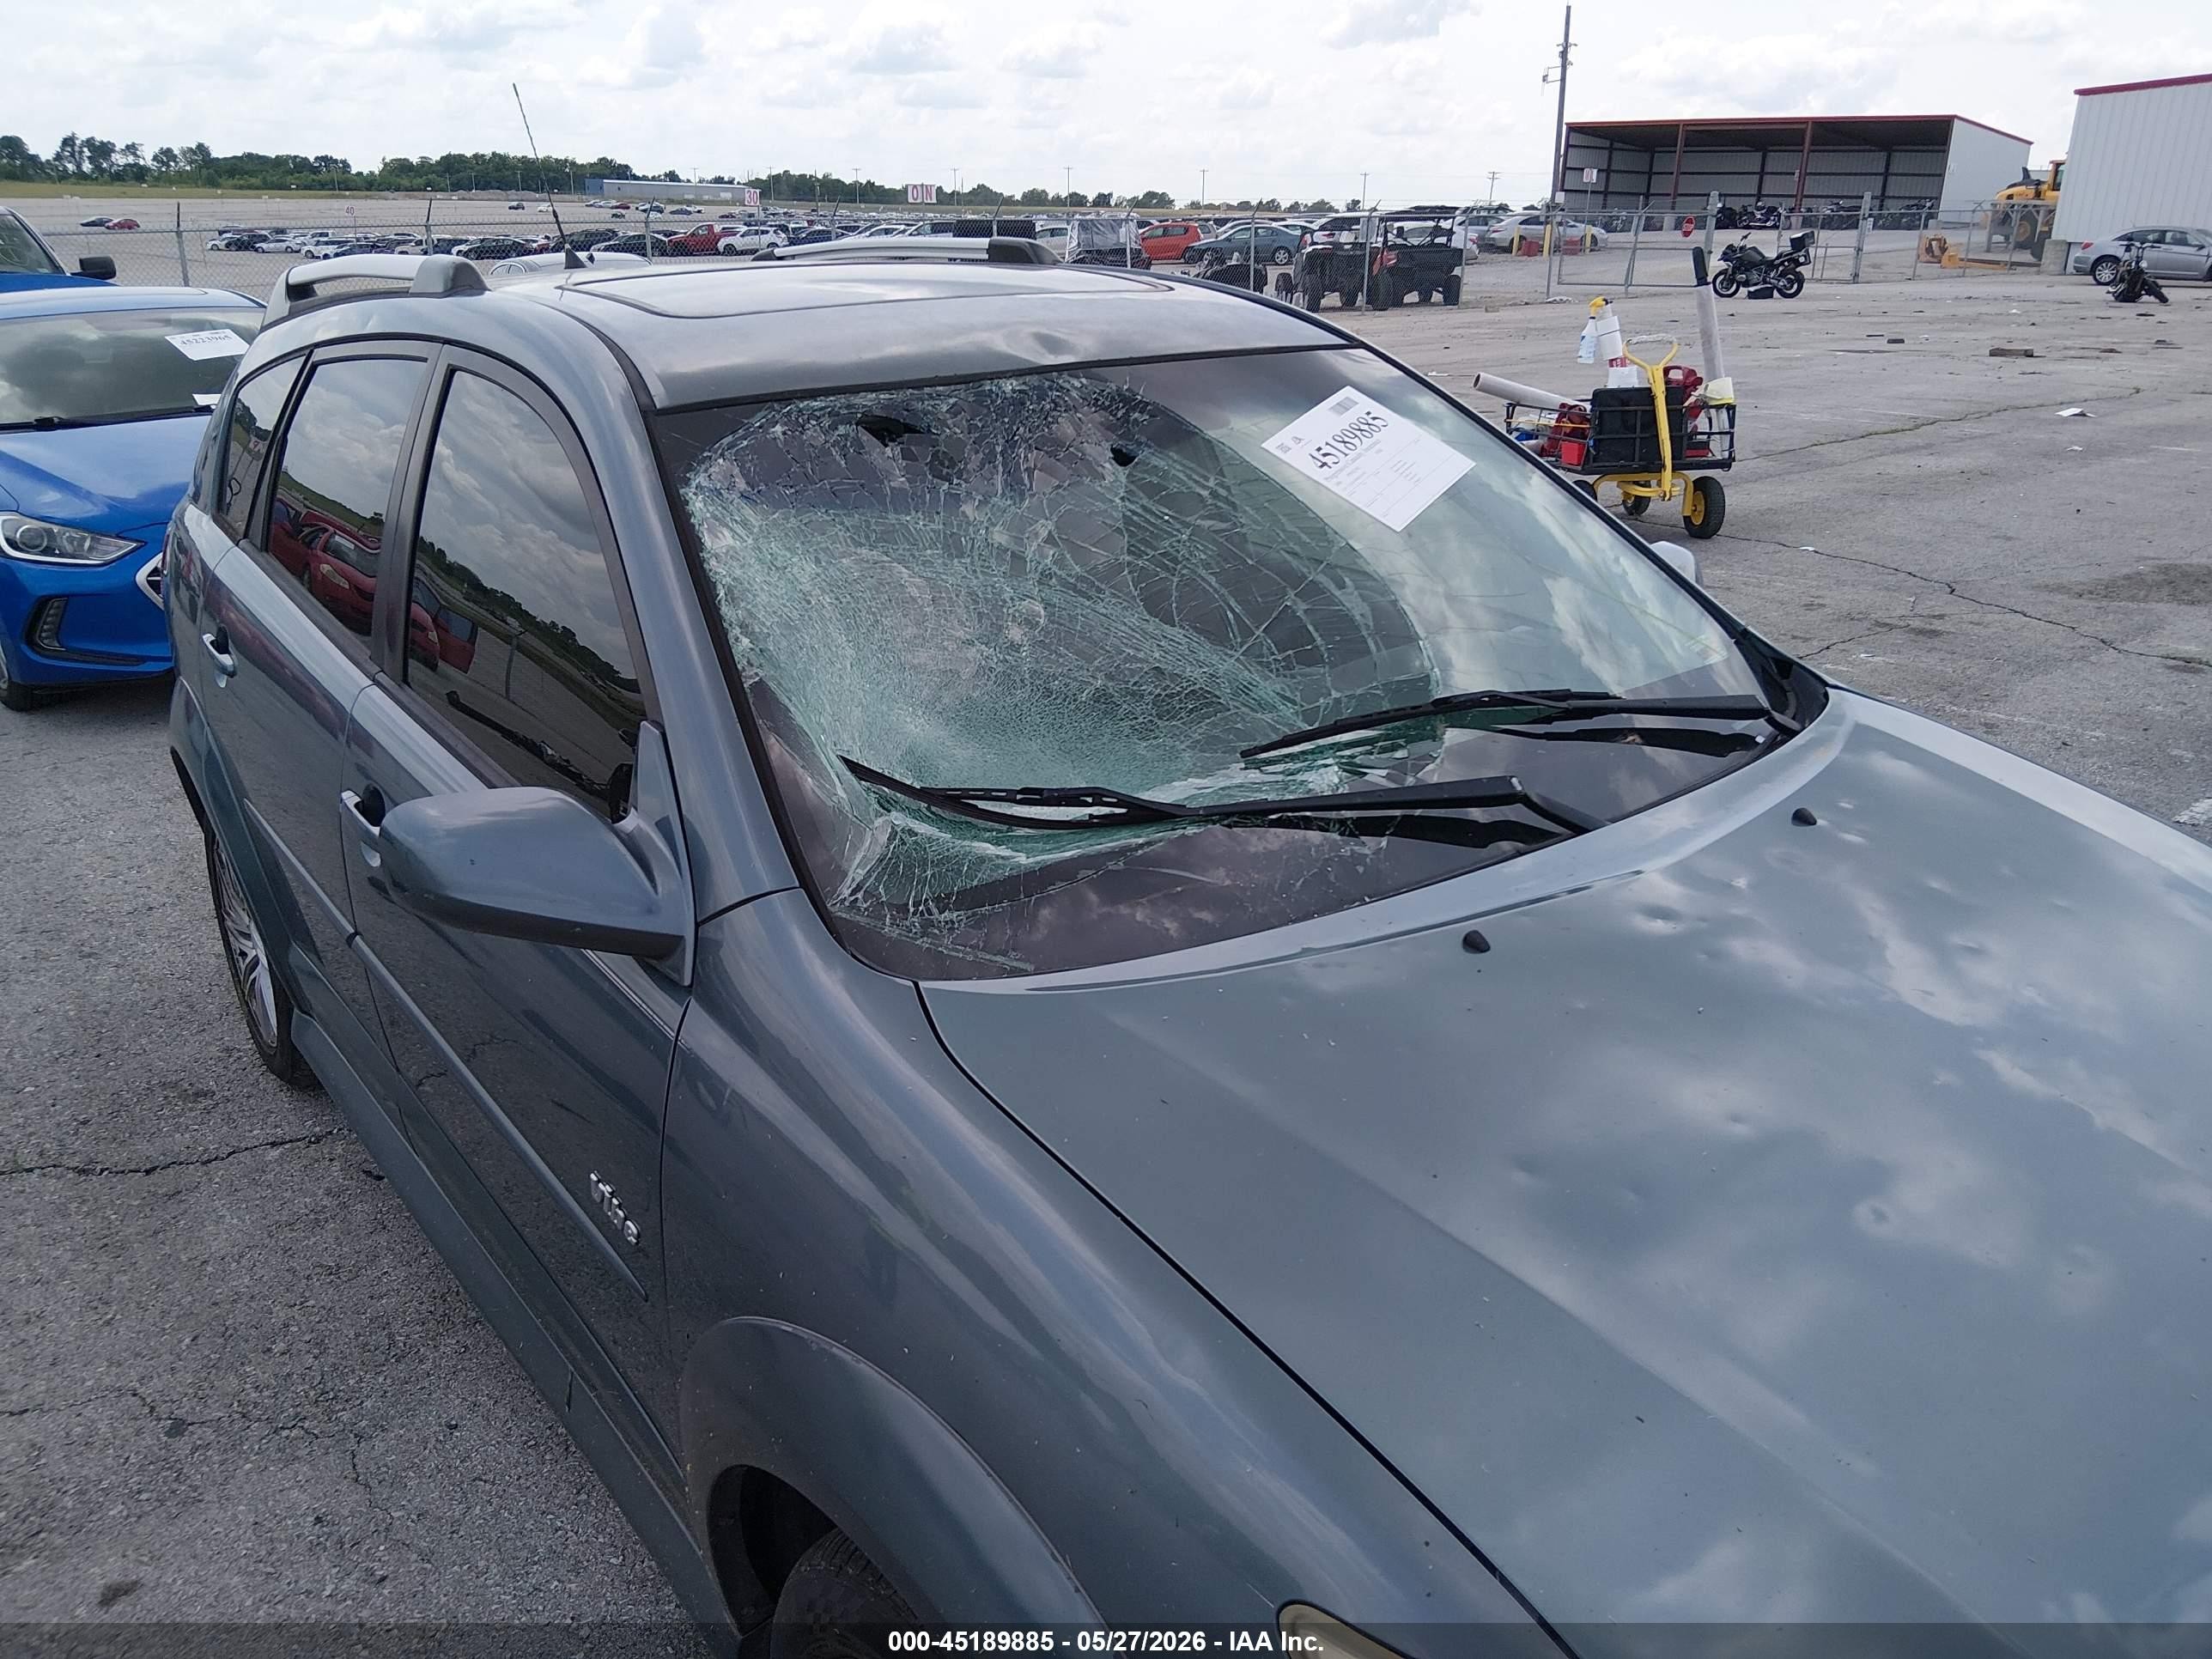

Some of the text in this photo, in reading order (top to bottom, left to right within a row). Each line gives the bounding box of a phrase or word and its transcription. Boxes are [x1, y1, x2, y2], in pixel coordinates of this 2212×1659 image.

[746, 190, 758, 205] 30
[345, 206, 355, 216] 40
[1309, 410, 1389, 469] 45189885
